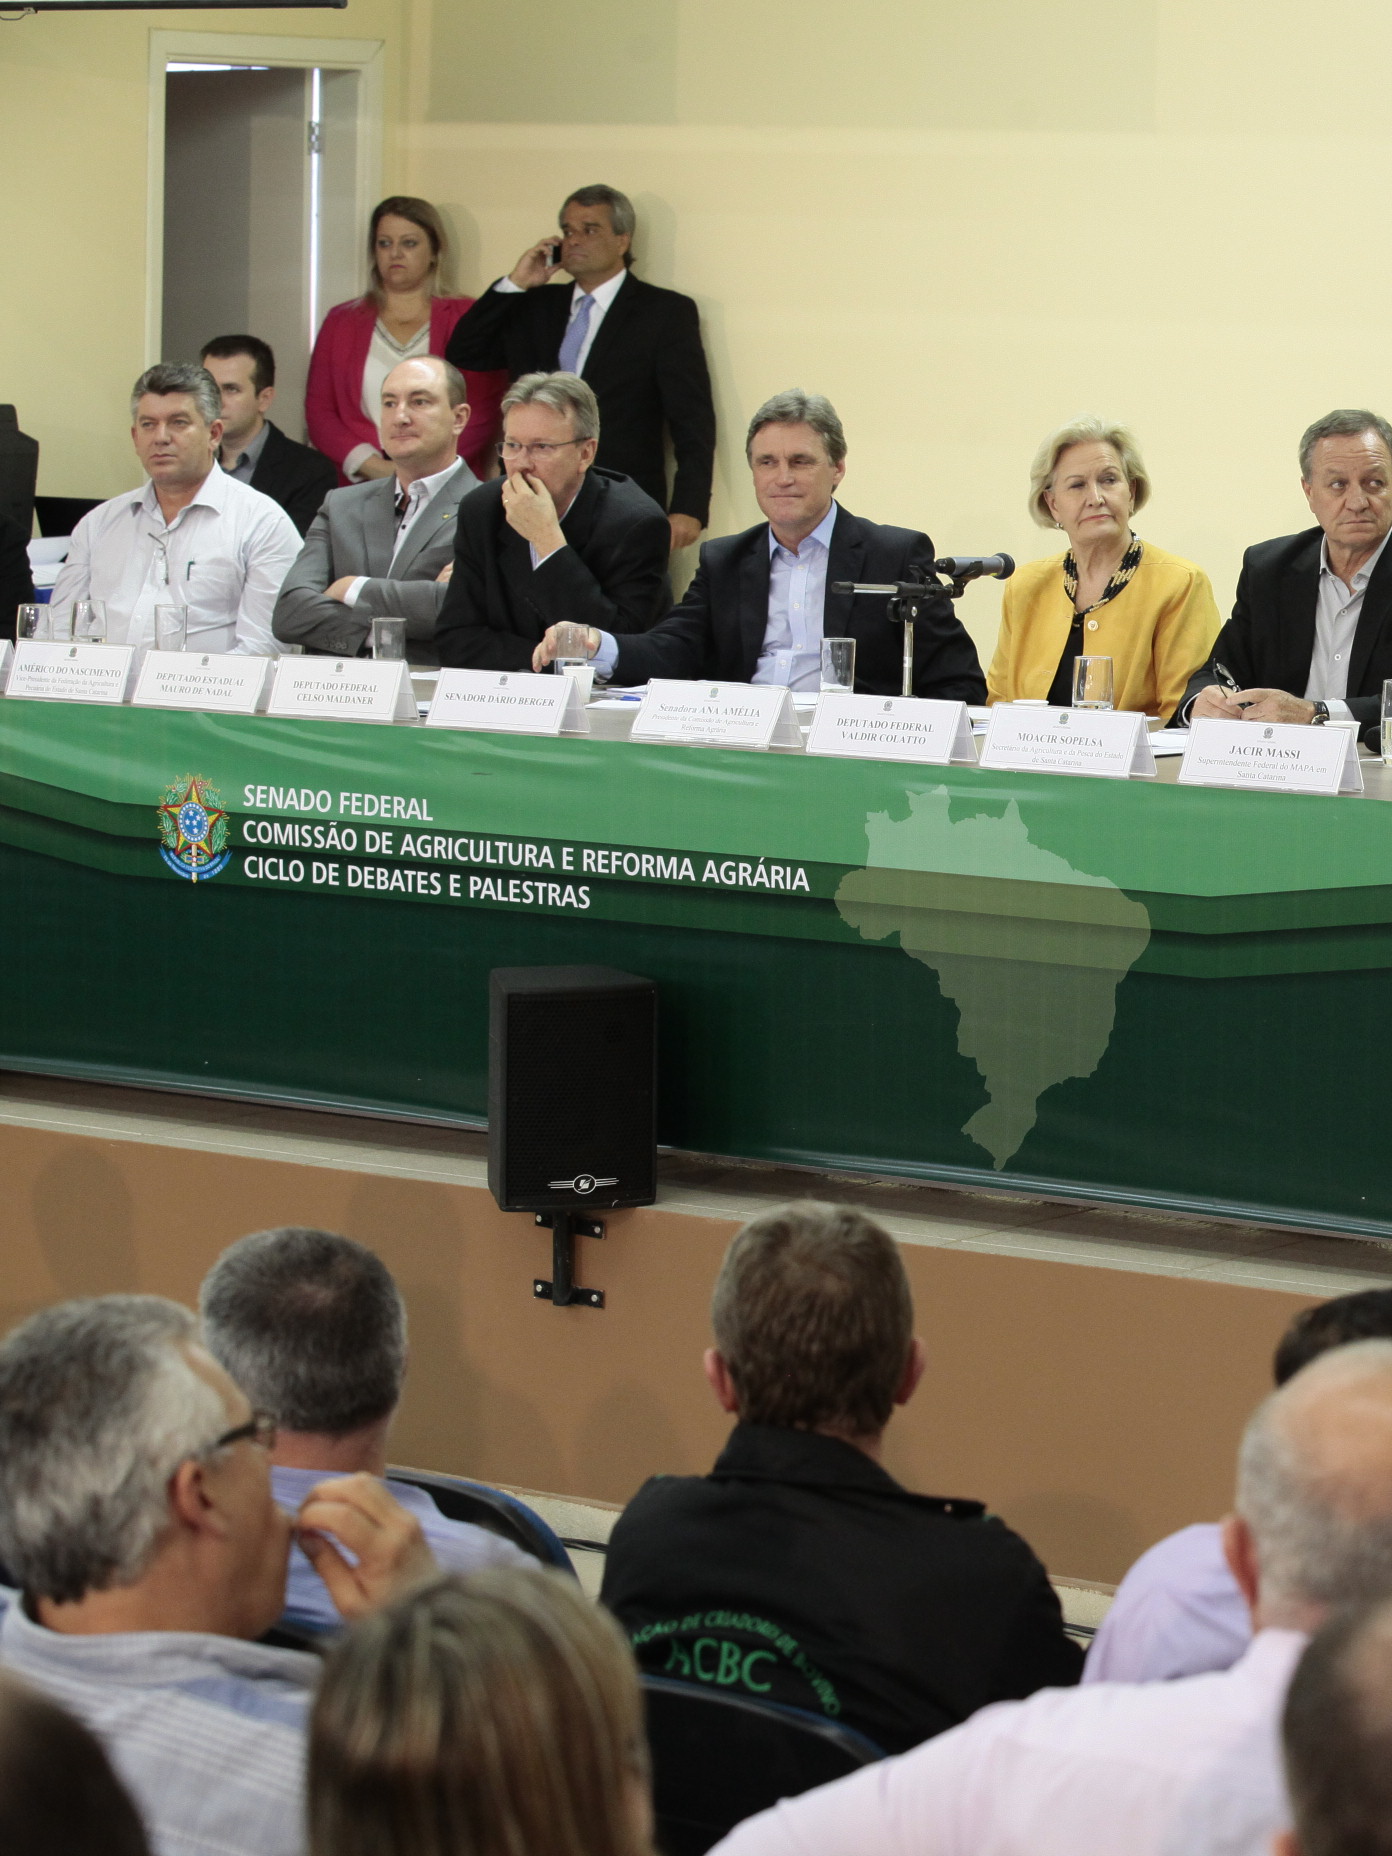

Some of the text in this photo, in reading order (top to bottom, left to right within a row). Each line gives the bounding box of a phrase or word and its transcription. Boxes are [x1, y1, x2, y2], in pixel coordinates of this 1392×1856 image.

[18, 663, 121, 678] AMÉRICO DO NASCIMENTO
[156, 672, 245, 686] DEPUTADO ESTADUAL
[160, 684, 233, 697] MAURO DE NADAL
[293, 680, 378, 693] DEPUTADO FEDERAL
[296, 693, 374, 705] CELSO MALDANER
[445, 692, 555, 707] SENADOR DÁRIO BERGER
[658, 703, 760, 717] Senadora ANA AMÉLIA
[836, 718, 934, 733] DEPUTADO FEDERAL
[842, 731, 926, 745] VALDIR COLATTO
[1017, 732, 1103, 747] MOACIR SOPELSA
[1030, 746, 1062, 755] Agricultura
[1077, 749, 1093, 757] Pesca
[1095, 750, 1102, 758] do
[1104, 751, 1123, 760] Estado
[1229, 745, 1301, 759] JACIR MASSI
[1057, 758, 1082, 766] Catarina
[1197, 756, 1251, 768] Superintendente
[1253, 761, 1278, 770] Federal
[1279, 762, 1288, 770] do
[1289, 764, 1314, 773] MAPA
[1237, 770, 1286, 781] Santa Catarina
[243, 784, 434, 821] SENADO FEDERAL
[242, 820, 811, 892] COMISSÃO DE AGRICULTURA E REFORMA AGRÁRIA
[244, 855, 305, 882] CICLO
[312, 861, 340, 886] DE
[347, 864, 442, 895] DEBATES
[449, 874, 462, 897] E
[469, 876, 591, 909] PALESTRAS
